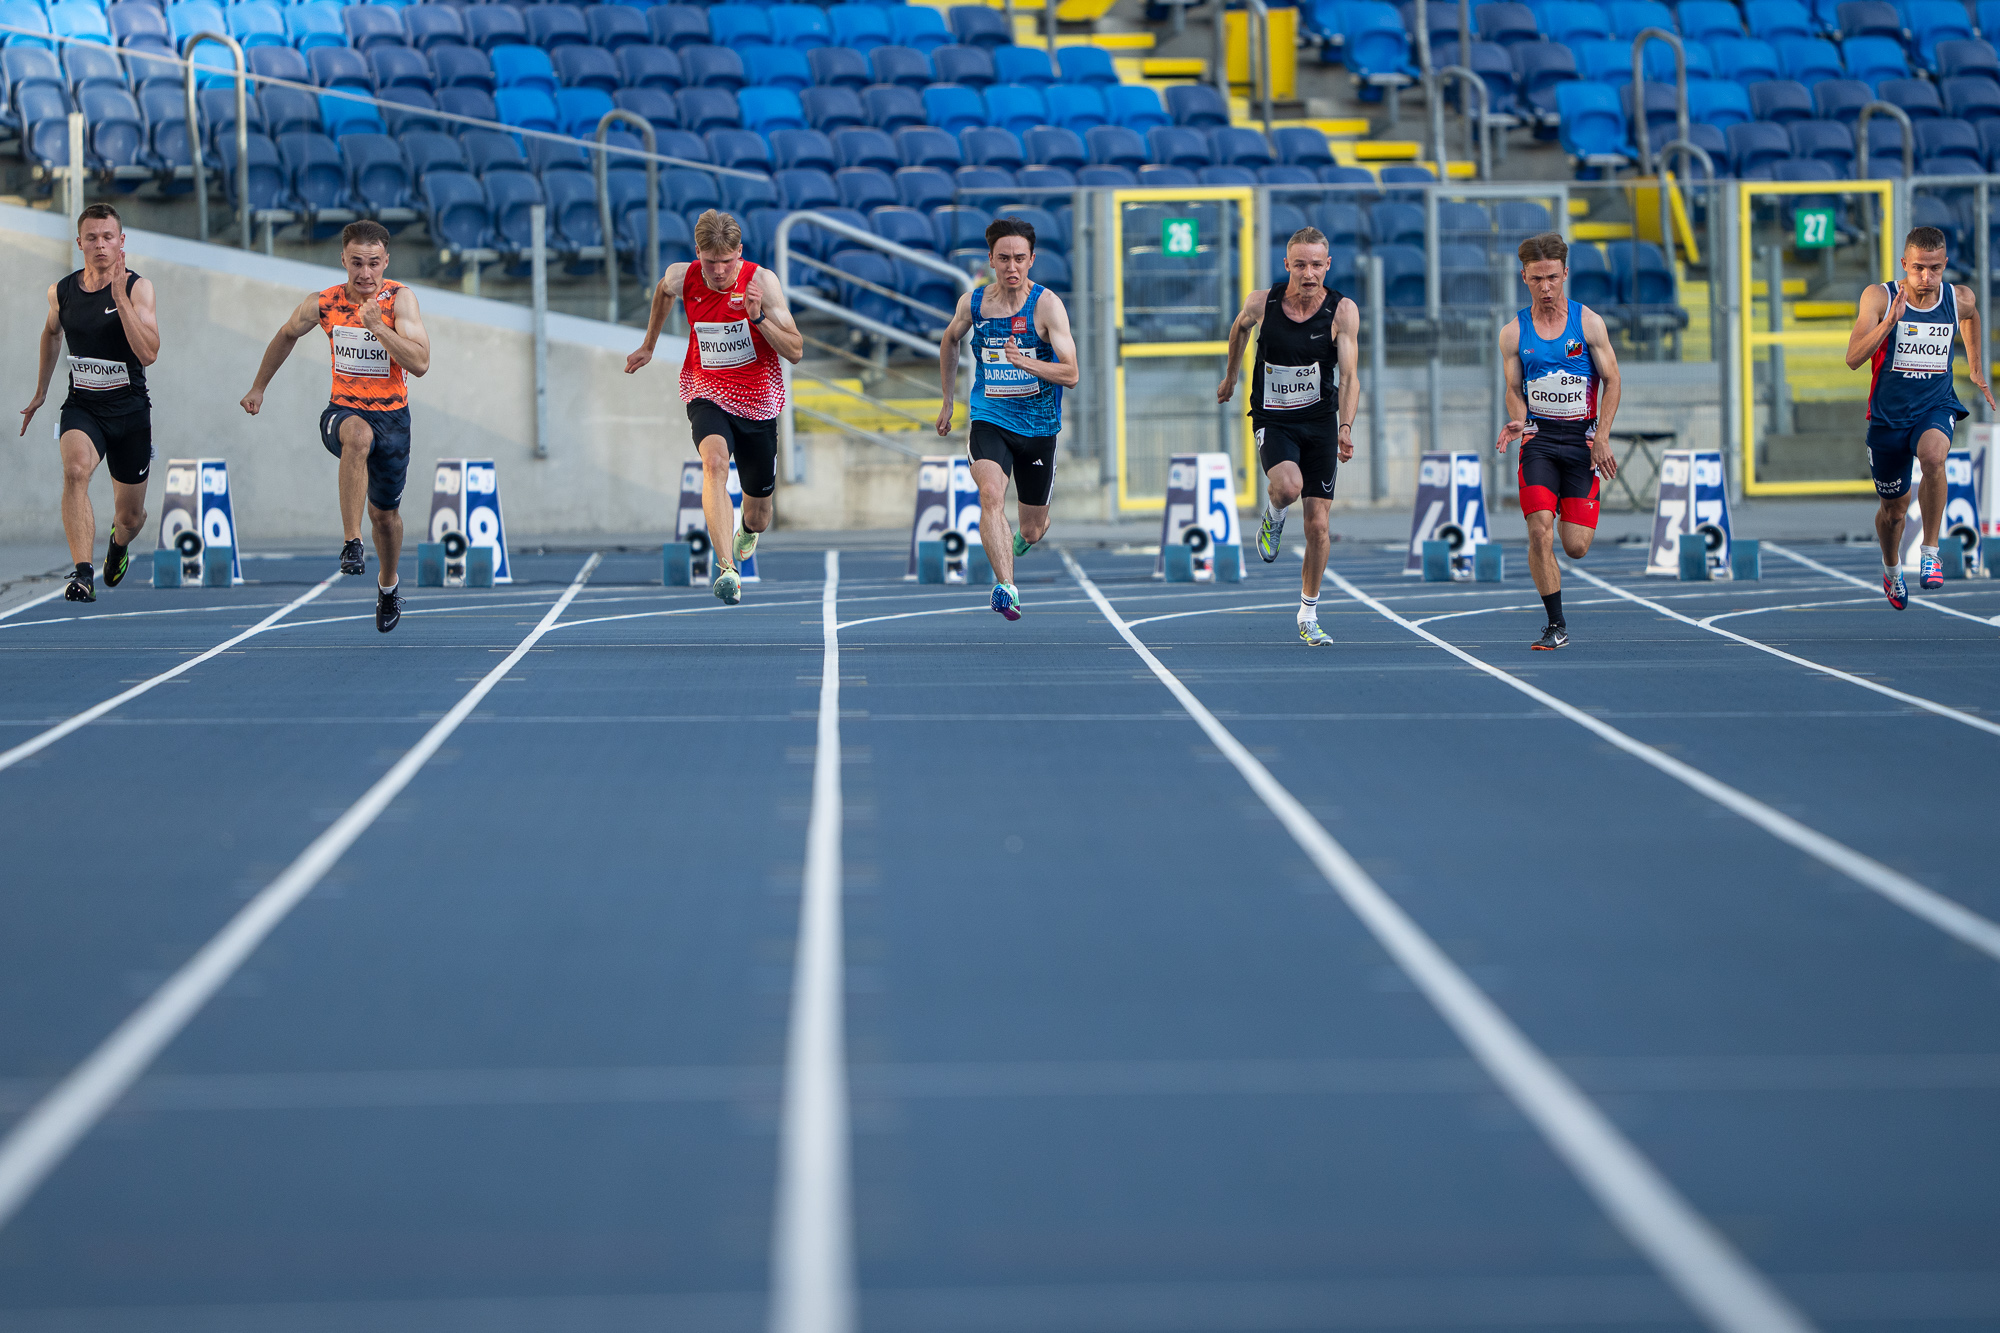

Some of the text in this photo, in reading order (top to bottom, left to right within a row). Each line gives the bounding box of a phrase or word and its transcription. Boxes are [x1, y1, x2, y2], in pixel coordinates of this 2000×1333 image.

[1803, 214, 1827, 242] 27
[1168, 222, 1192, 252] 26
[724, 323, 743, 335] 547
[1929, 326, 1949, 337] 210
[364, 332, 380, 342] 36
[700, 337, 751, 352] BRYLOWSKI
[1897, 342, 1948, 356] SZAKOŁA
[336, 345, 388, 360] MATULSKI
[72, 363, 126, 375] LEPIONKA
[1296, 367, 1316, 377] 634
[1271, 382, 1315, 394] LIBURA
[1561, 376, 1582, 386] 838
[1531, 390, 1582, 403] GRODEK
[1209, 479, 1230, 545] 5
[1460, 500, 1489, 556] 4
[1655, 500, 1686, 567] 3
[469, 506, 502, 576] 8
